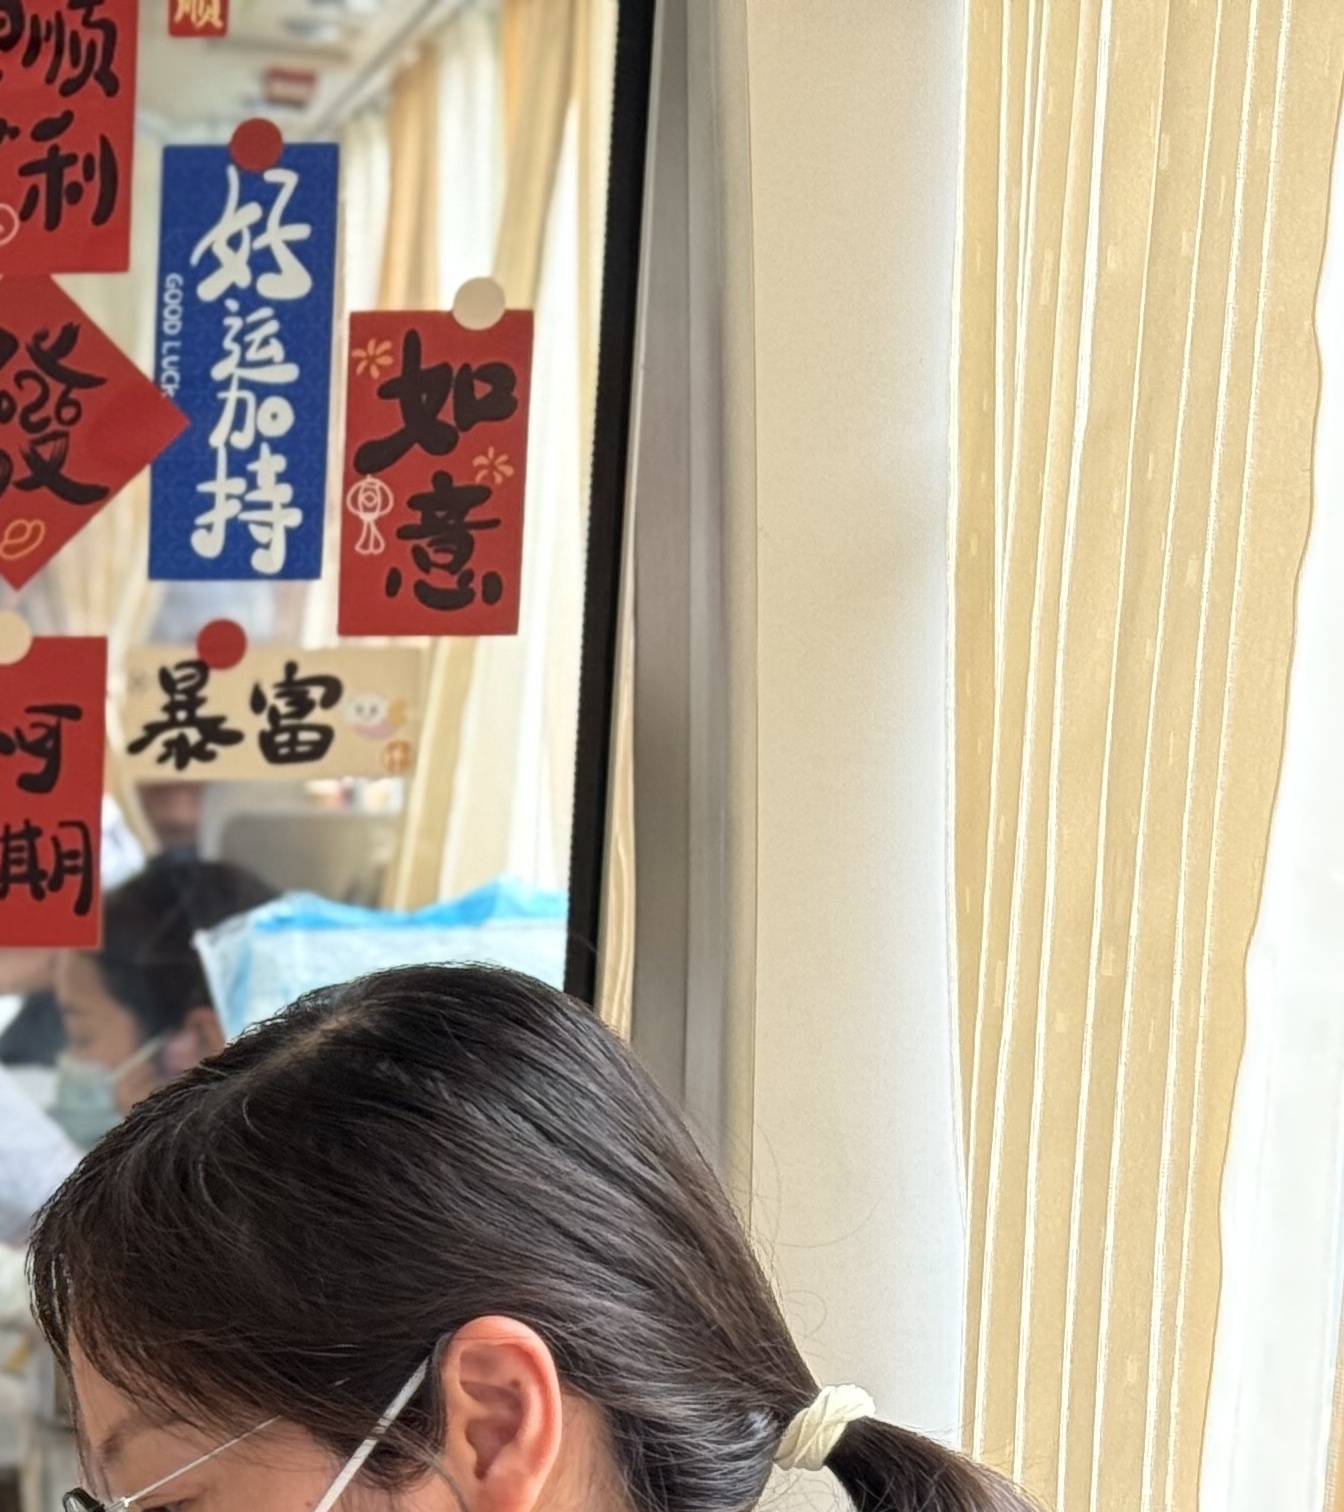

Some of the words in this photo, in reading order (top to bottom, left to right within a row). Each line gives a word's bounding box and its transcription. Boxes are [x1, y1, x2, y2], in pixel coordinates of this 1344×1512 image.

[18, 0, 121, 232] 顺利
[162, 273, 183, 336] GOOD
[190, 164, 313, 575] 好运加持
[353, 329, 519, 611] 如意
[127, 660, 344, 771] 暴富
